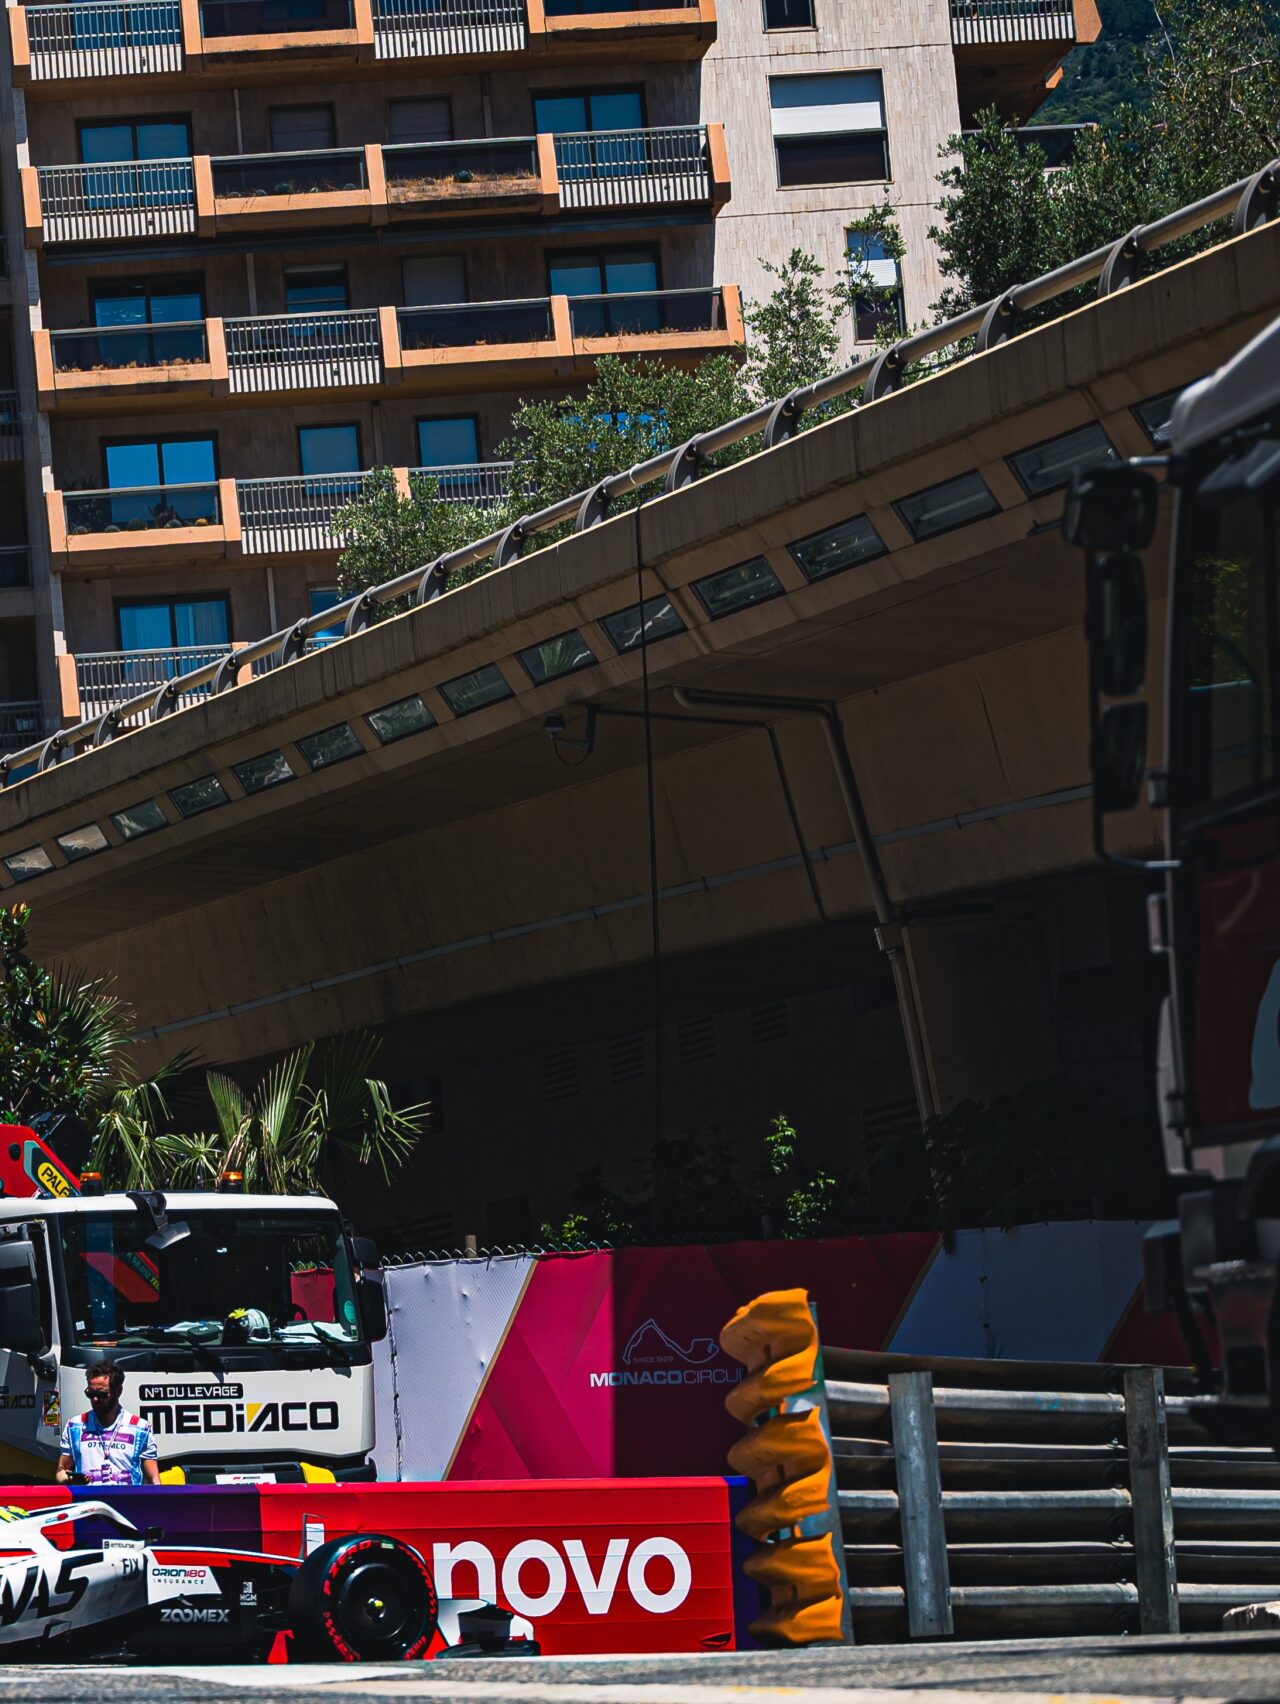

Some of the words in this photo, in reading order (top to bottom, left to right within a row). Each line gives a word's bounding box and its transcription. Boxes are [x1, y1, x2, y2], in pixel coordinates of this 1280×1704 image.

[590, 1368, 745, 1388] MONACOCIRCUI
[167, 1387, 184, 1397] DU
[187, 1386, 238, 1397] LEVAGE
[122, 1558, 140, 1574] FIX
[160, 1608, 230, 1622] ZOOMEX
